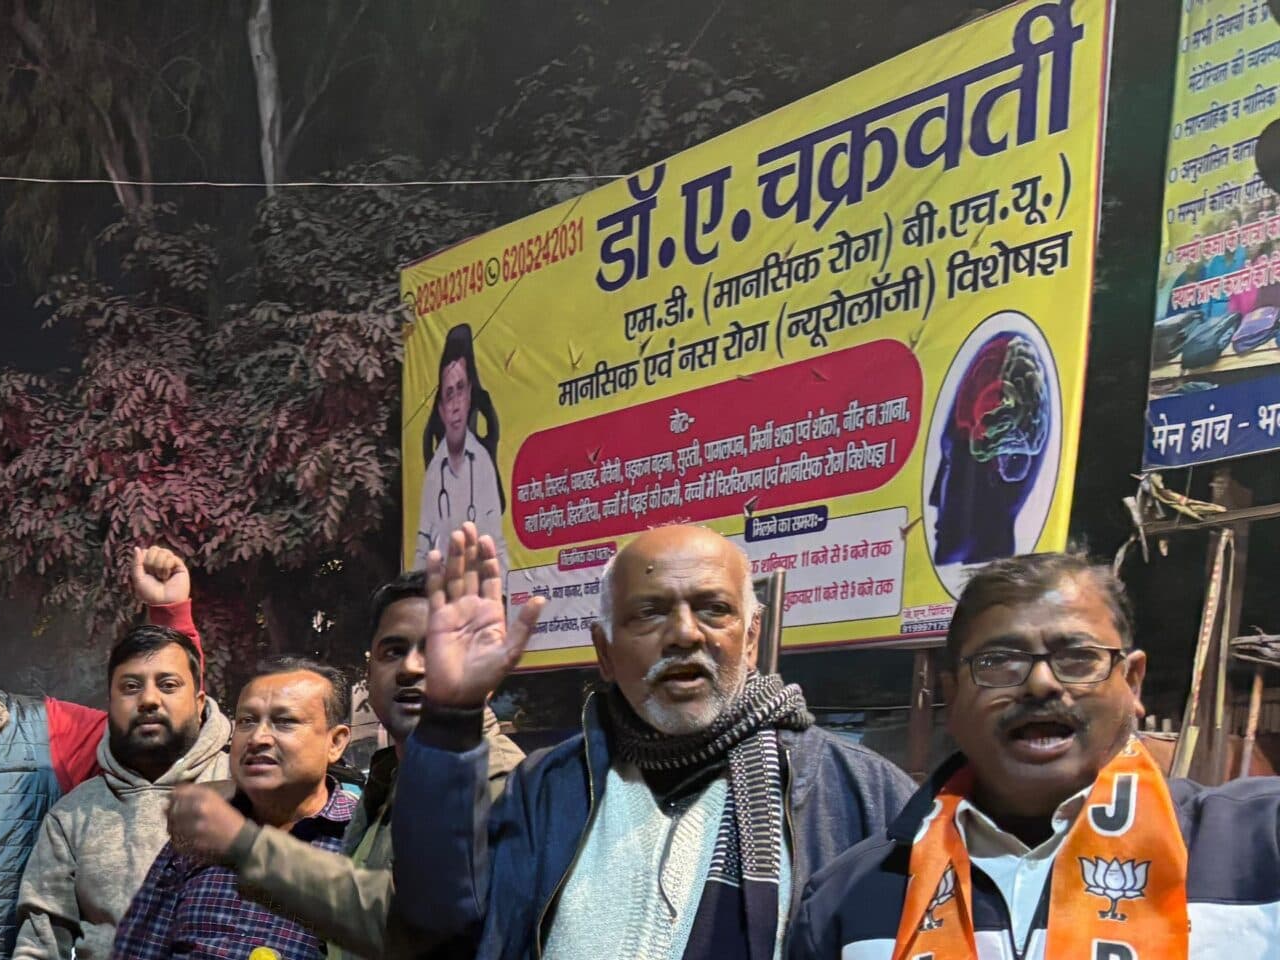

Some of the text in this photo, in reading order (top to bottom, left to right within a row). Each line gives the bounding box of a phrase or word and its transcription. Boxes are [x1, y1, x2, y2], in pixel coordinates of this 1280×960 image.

[501, 216, 584, 283] 6205242031
[558, 360, 637, 407] मानसिक
[643, 339, 673, 386] एवं
[677, 334, 718, 374] नस
[723, 318, 770, 362] रोग
[946, 230, 1075, 300] विशेषज्ञ
[866, 404, 877, 426] न
[879, 397, 911, 426] आना,
[1152, 413, 1186, 455] मेन
[1191, 404, 1233, 452] ब्रांच
[705, 470, 715, 498] में
[779, 451, 824, 485] मानसिक
[825, 447, 845, 476] रोग
[752, 515, 777, 538] मिलने
[778, 517, 791, 532] का
[761, 552, 798, 573] शनिवार
[811, 545, 829, 565] बजे
[831, 544, 841, 563] से
[850, 539, 869, 559] बजे
[871, 540, 894, 558] तक
[823, 581, 838, 600] बजे
[840, 580, 849, 599] से
[858, 577, 874, 597] बजे
[876, 578, 895, 595] तक
[1088, 773, 1138, 836] J
